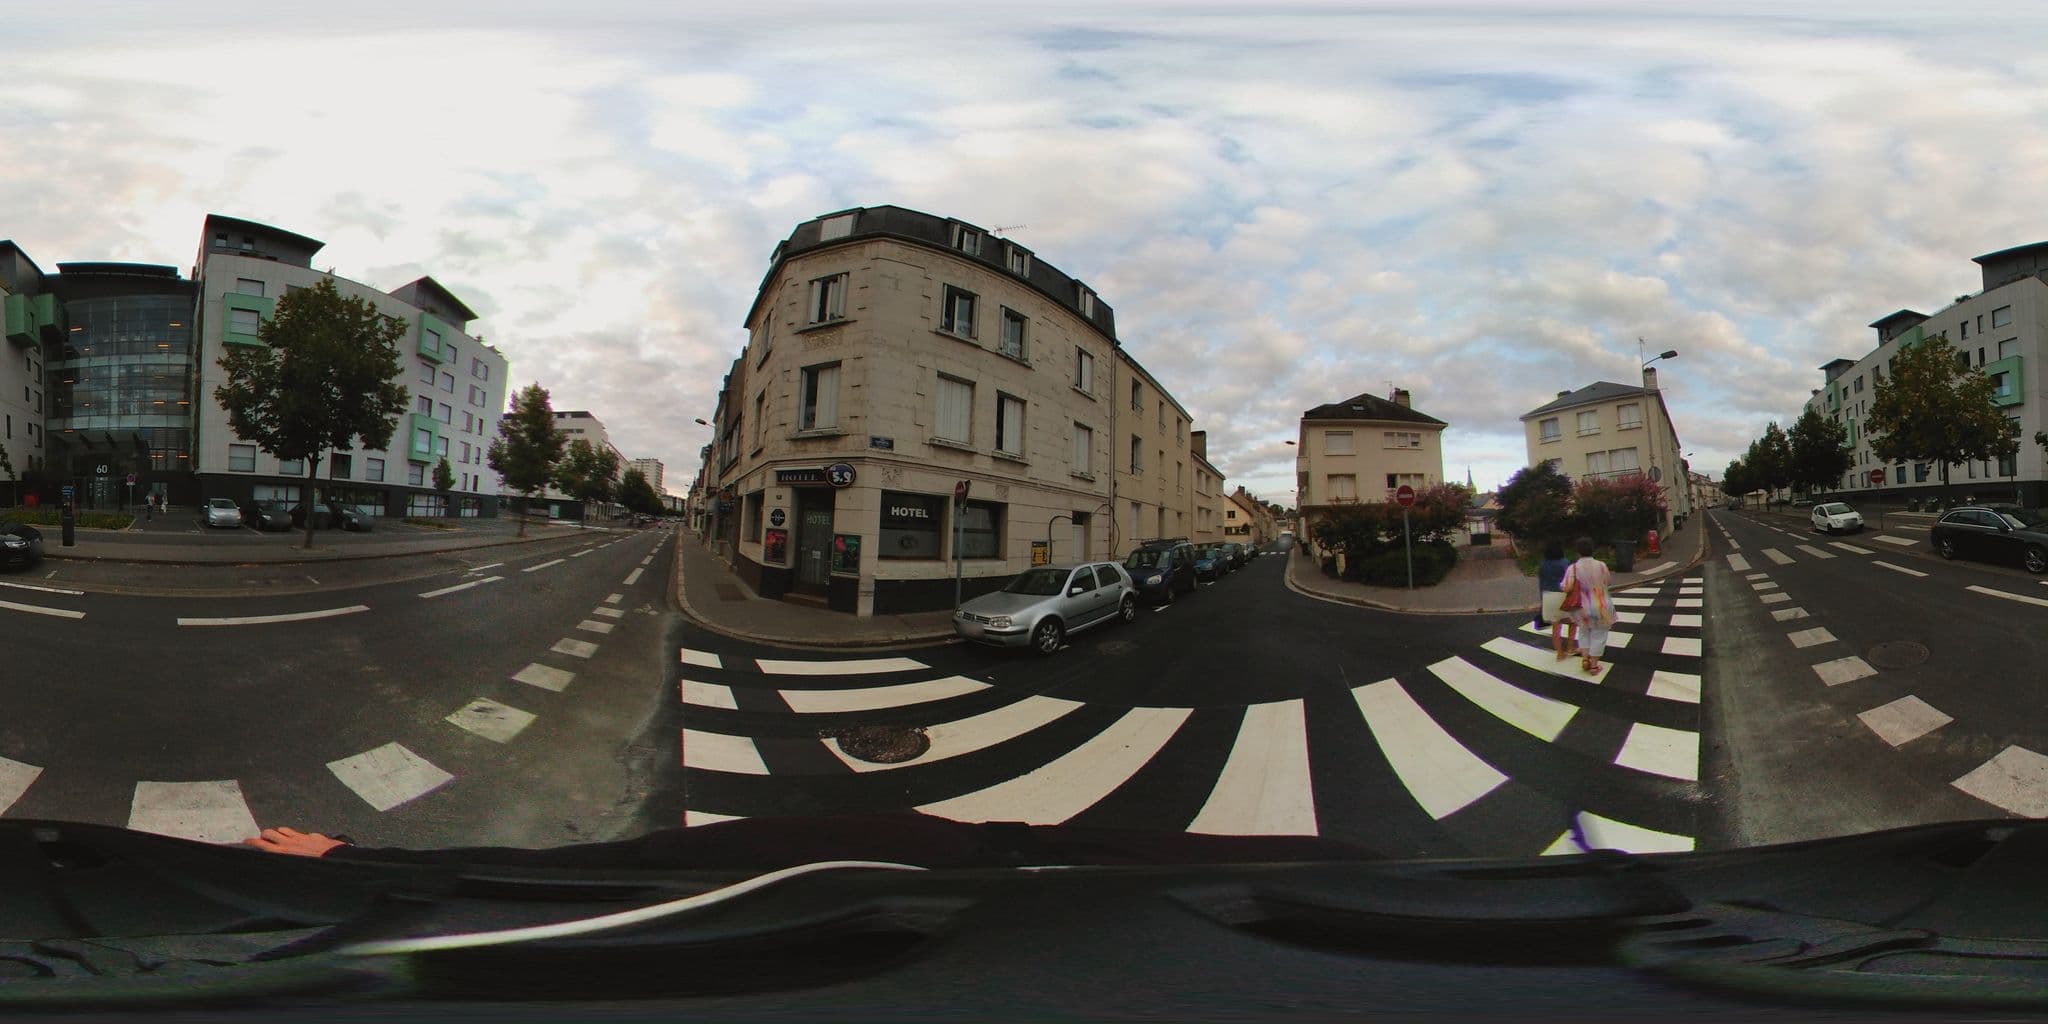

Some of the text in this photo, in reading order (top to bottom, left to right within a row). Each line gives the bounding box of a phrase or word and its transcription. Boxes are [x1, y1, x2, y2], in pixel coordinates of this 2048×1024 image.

[96, 464, 108, 474] 60
[891, 506, 929, 519] HOTEL
[806, 514, 832, 526] HOTEL
